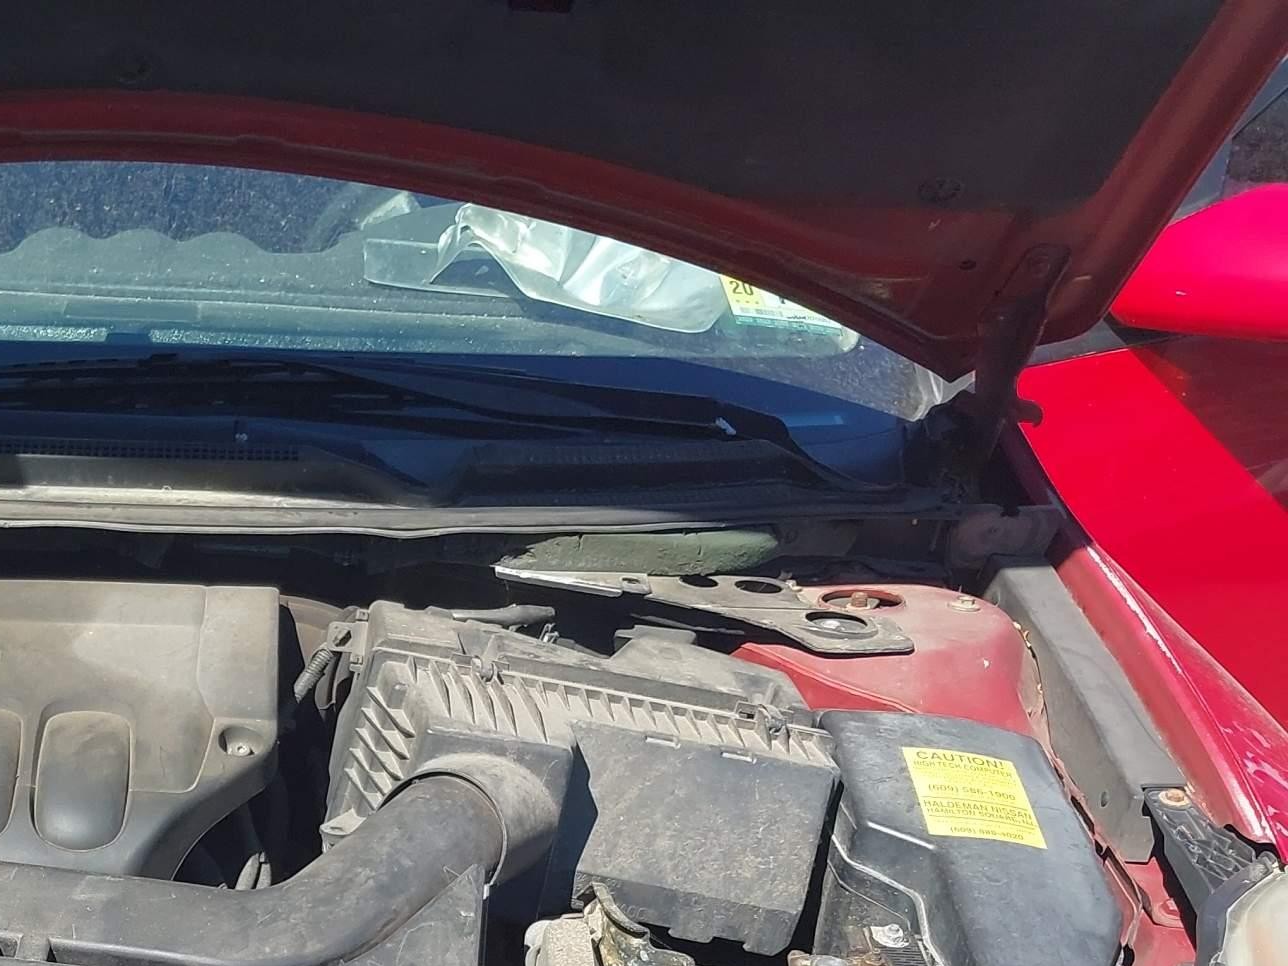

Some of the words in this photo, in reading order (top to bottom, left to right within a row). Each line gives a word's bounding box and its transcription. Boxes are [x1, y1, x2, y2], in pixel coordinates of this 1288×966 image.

[914, 760, 936, 768] HIGH
[936, 761, 962, 770] TECH
[964, 764, 1013, 778] COMPUTER
[916, 751, 1005, 770] CAUTION!
[928, 784, 959, 793] (609)
[923, 800, 989, 812] HALDEMAN
[991, 806, 1033, 821] NISSAN
[927, 808, 976, 817] HAMILTON
